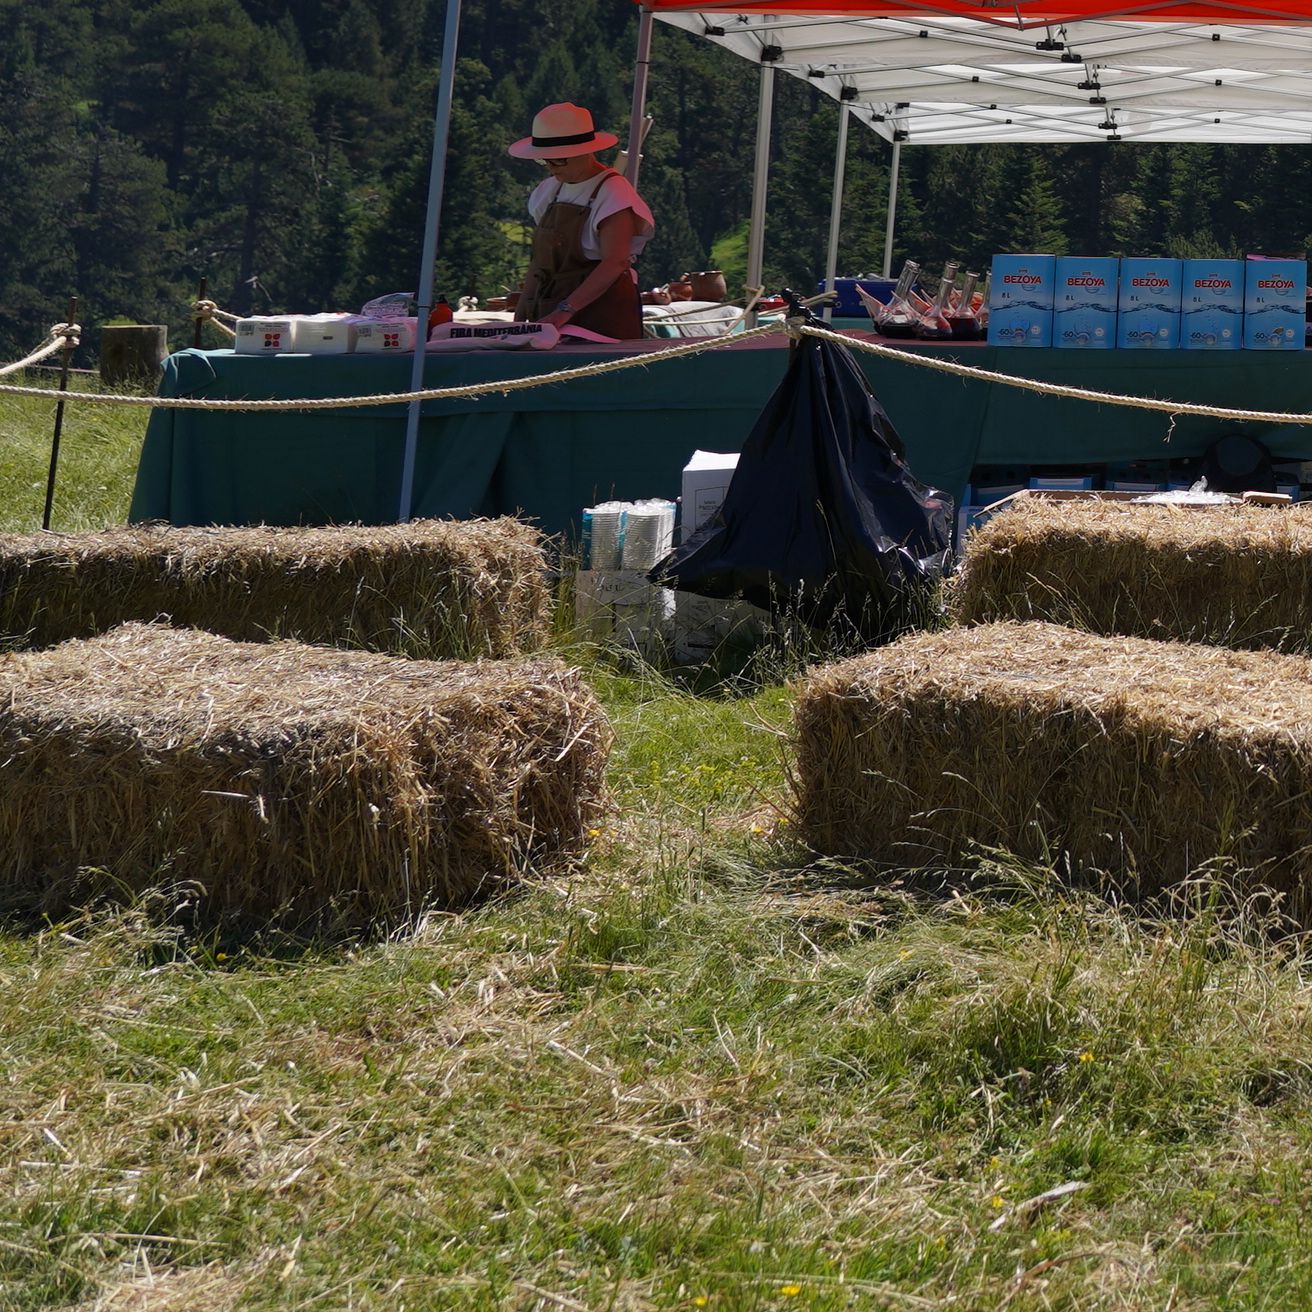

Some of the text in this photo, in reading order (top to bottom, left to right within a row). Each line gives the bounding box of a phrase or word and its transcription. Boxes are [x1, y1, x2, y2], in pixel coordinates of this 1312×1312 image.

[1003, 275, 1042, 284] BEZOYA
[1067, 278, 1105, 287] BEZOYA
[1132, 278, 1170, 287] BEZOYA
[1195, 279, 1232, 288] BEZOYA
[1258, 280, 1295, 288] BEZOYA
[450, 328, 472, 338] FIRA
